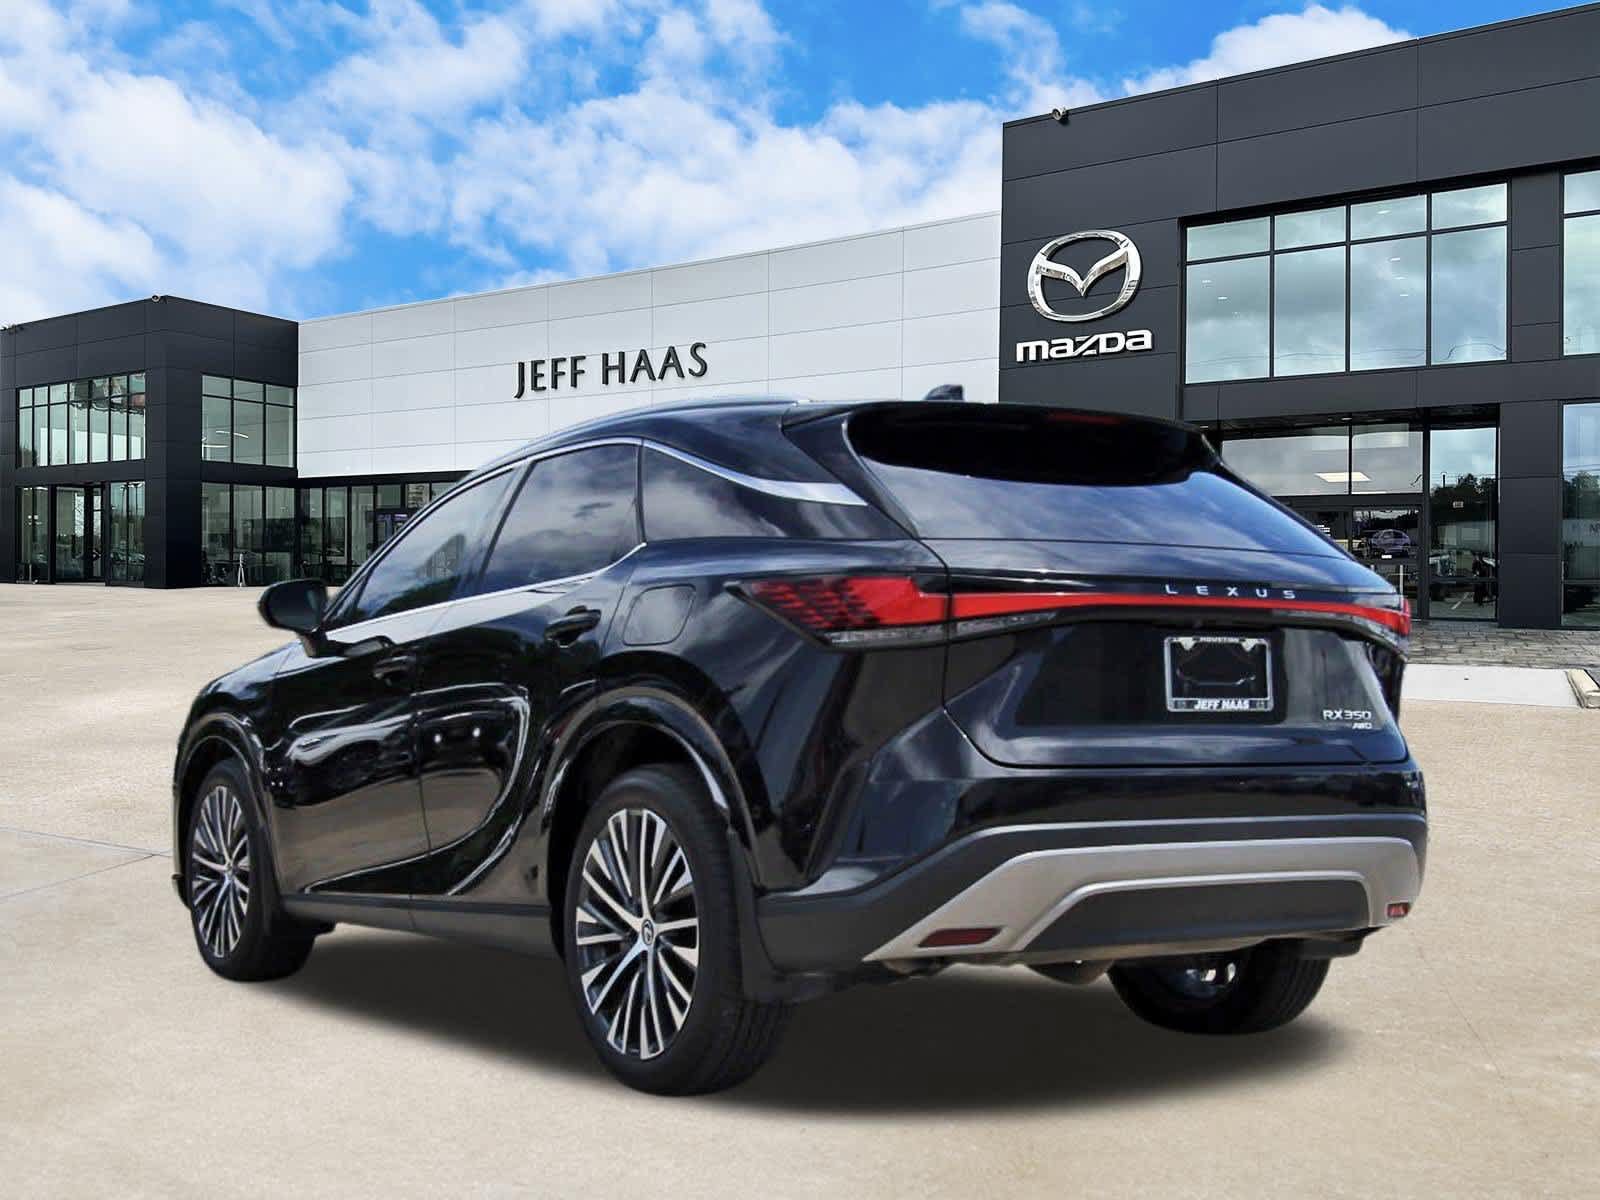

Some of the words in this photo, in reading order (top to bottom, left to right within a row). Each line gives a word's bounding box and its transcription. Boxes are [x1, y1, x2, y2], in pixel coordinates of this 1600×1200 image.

[514, 355, 587, 399] JEFF
[602, 342, 708, 384] HAAS
[1165, 583, 1296, 600] LEXUS
[1194, 699, 1220, 710] JEFF
[1221, 699, 1249, 710] HAAS
